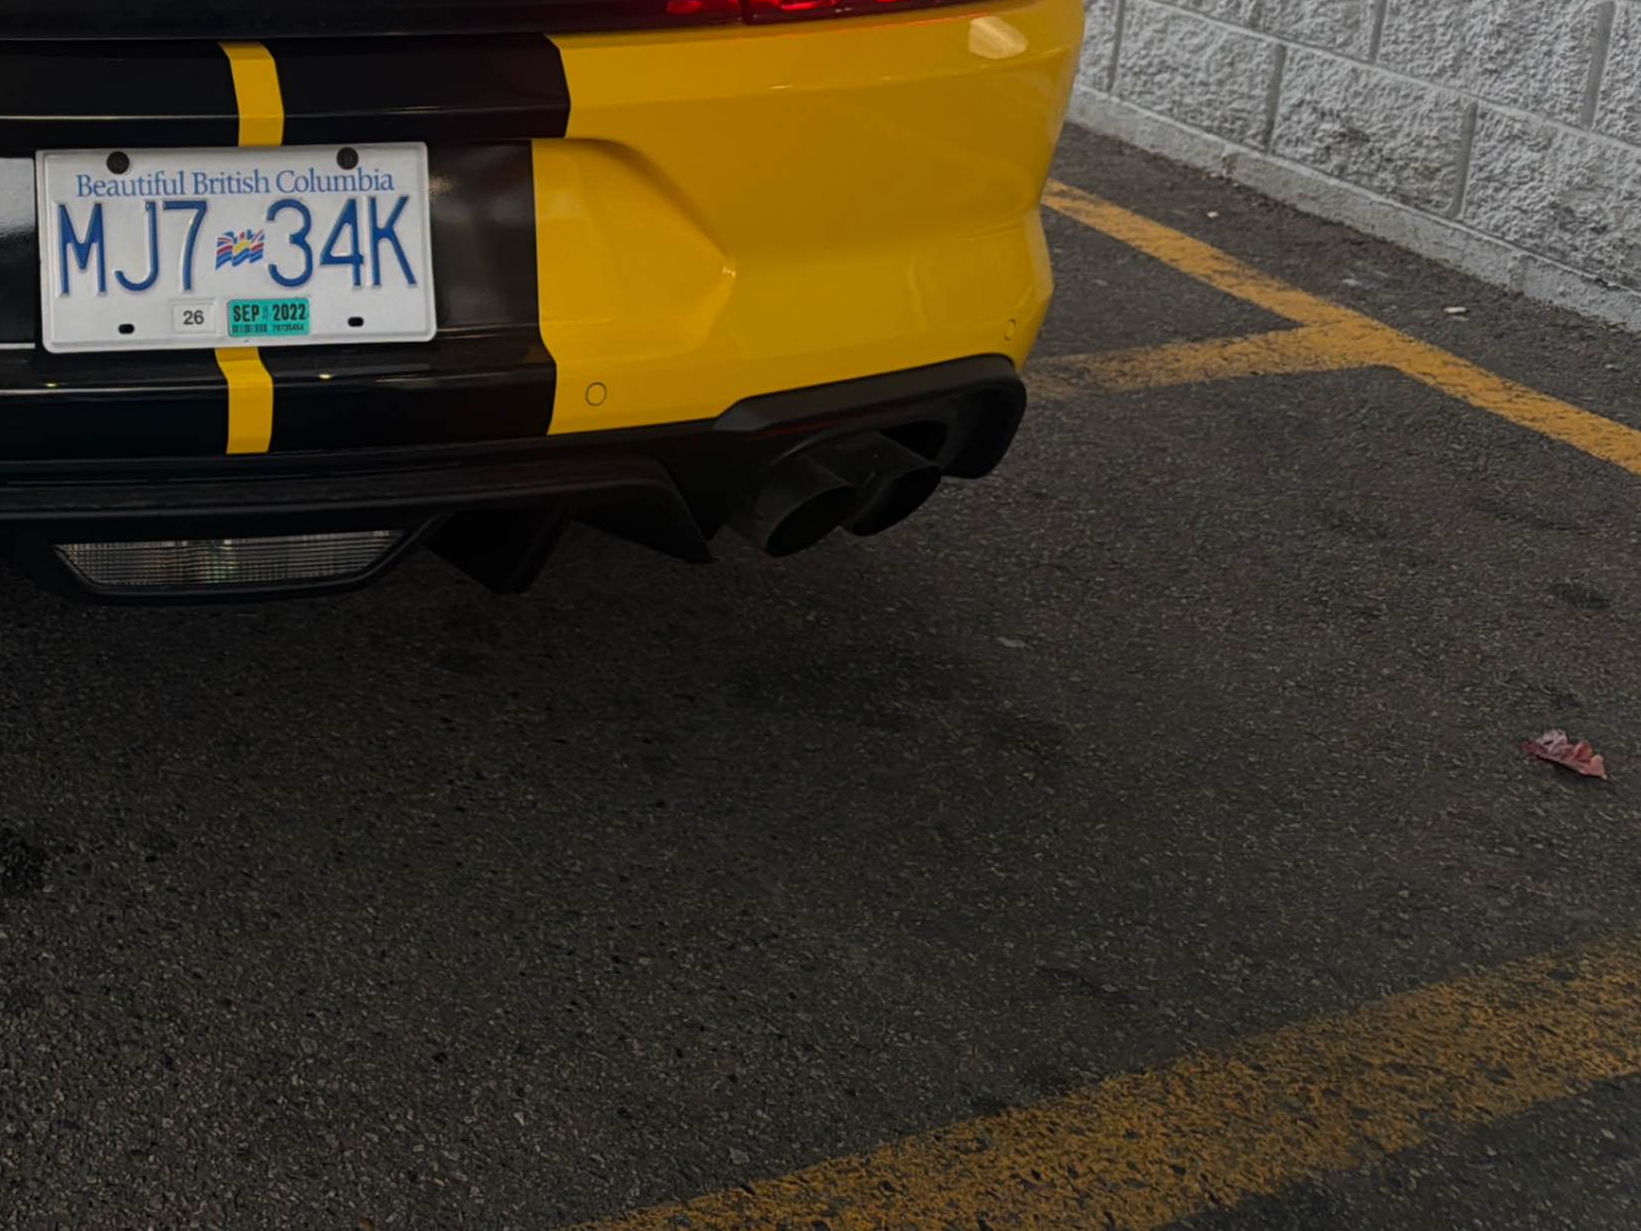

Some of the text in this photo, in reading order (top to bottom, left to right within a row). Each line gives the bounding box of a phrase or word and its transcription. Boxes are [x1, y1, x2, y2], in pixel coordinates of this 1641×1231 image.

[76, 167, 395, 198] Beautiful British Columbia
[58, 194, 418, 295] MJ7 34K
[182, 309, 205, 326] 26
[232, 302, 307, 323] SEP 2022
